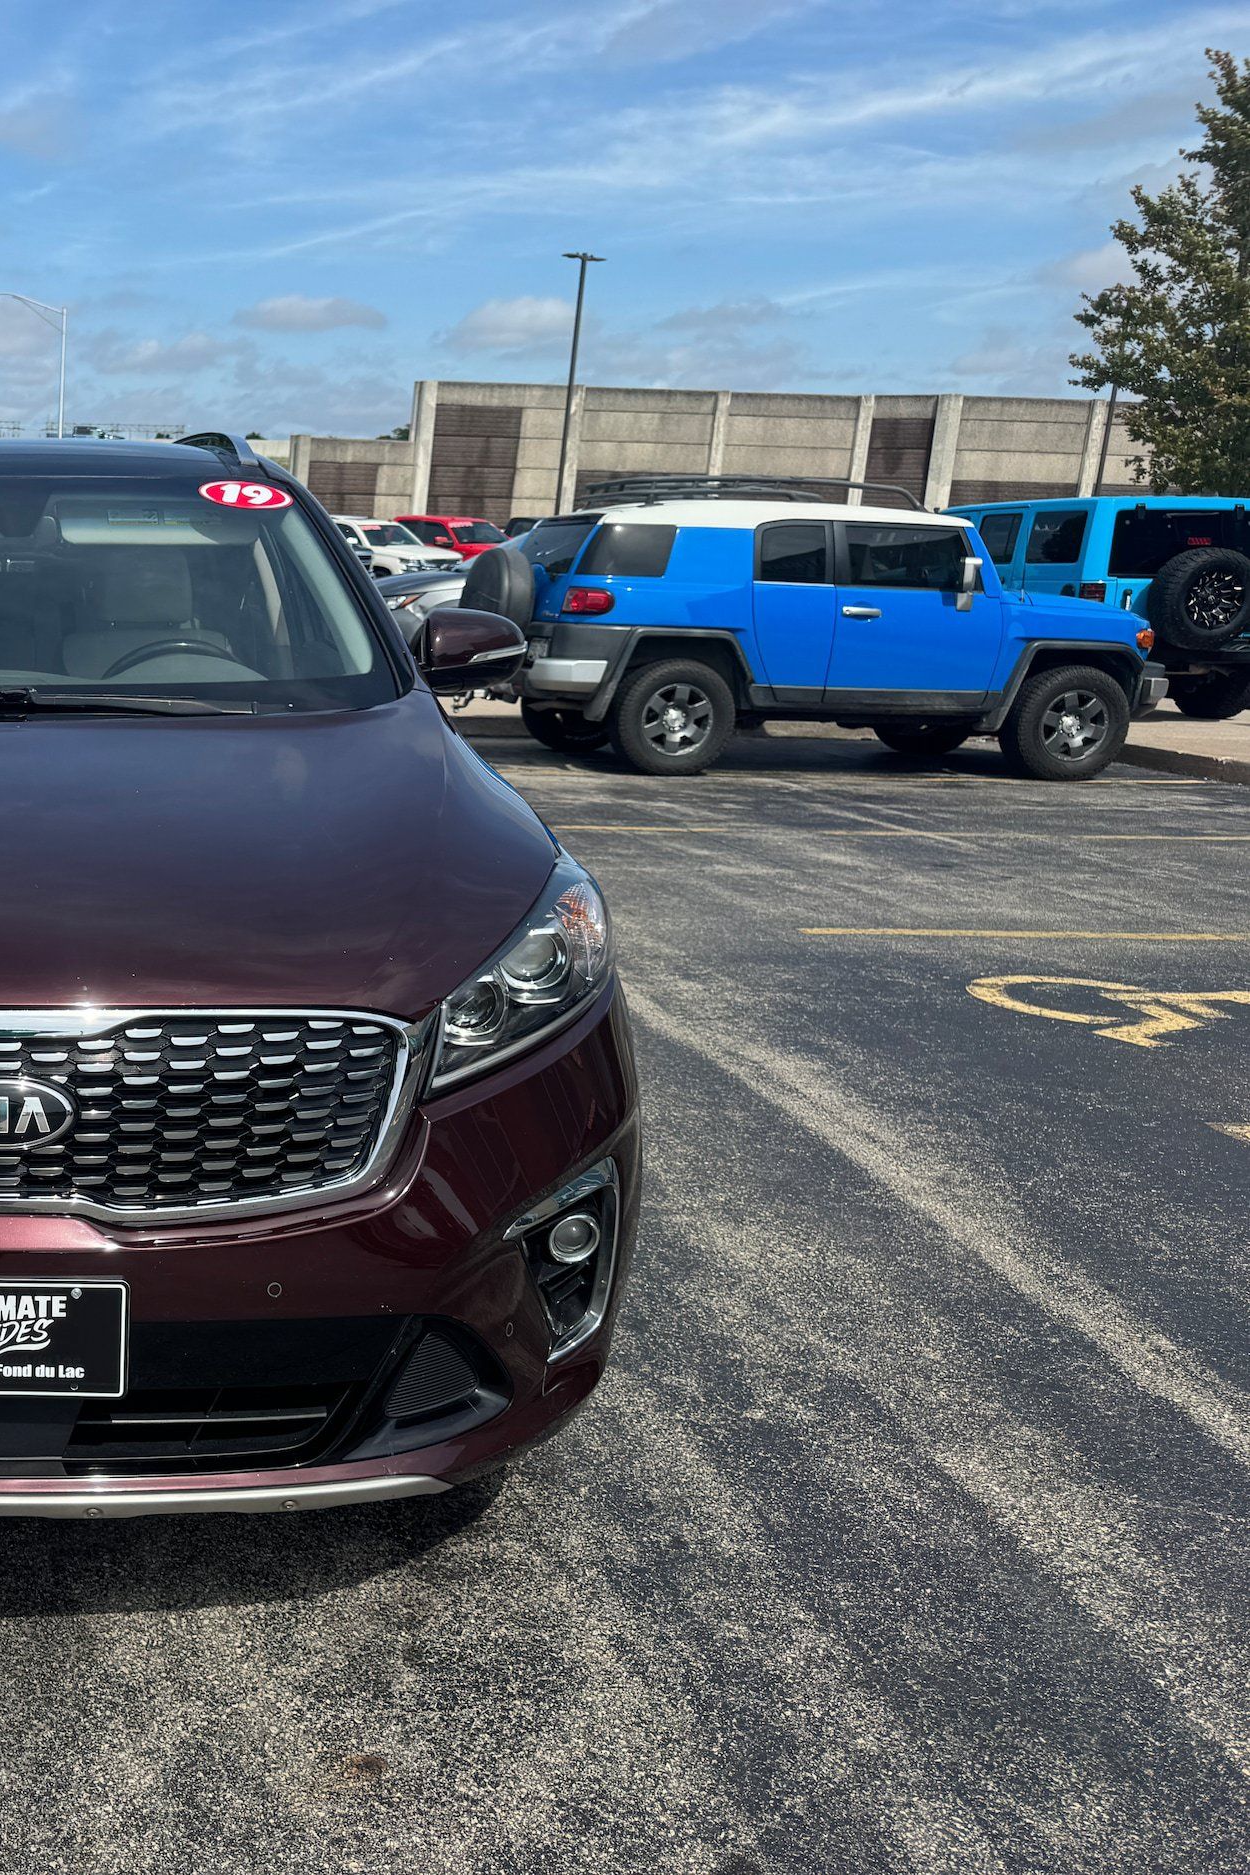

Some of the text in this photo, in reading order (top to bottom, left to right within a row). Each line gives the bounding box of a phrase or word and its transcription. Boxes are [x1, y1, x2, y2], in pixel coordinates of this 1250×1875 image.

[220, 483, 273, 505] 19
[35, 1364, 55, 1378] du
[58, 1365, 85, 1378] Lac
